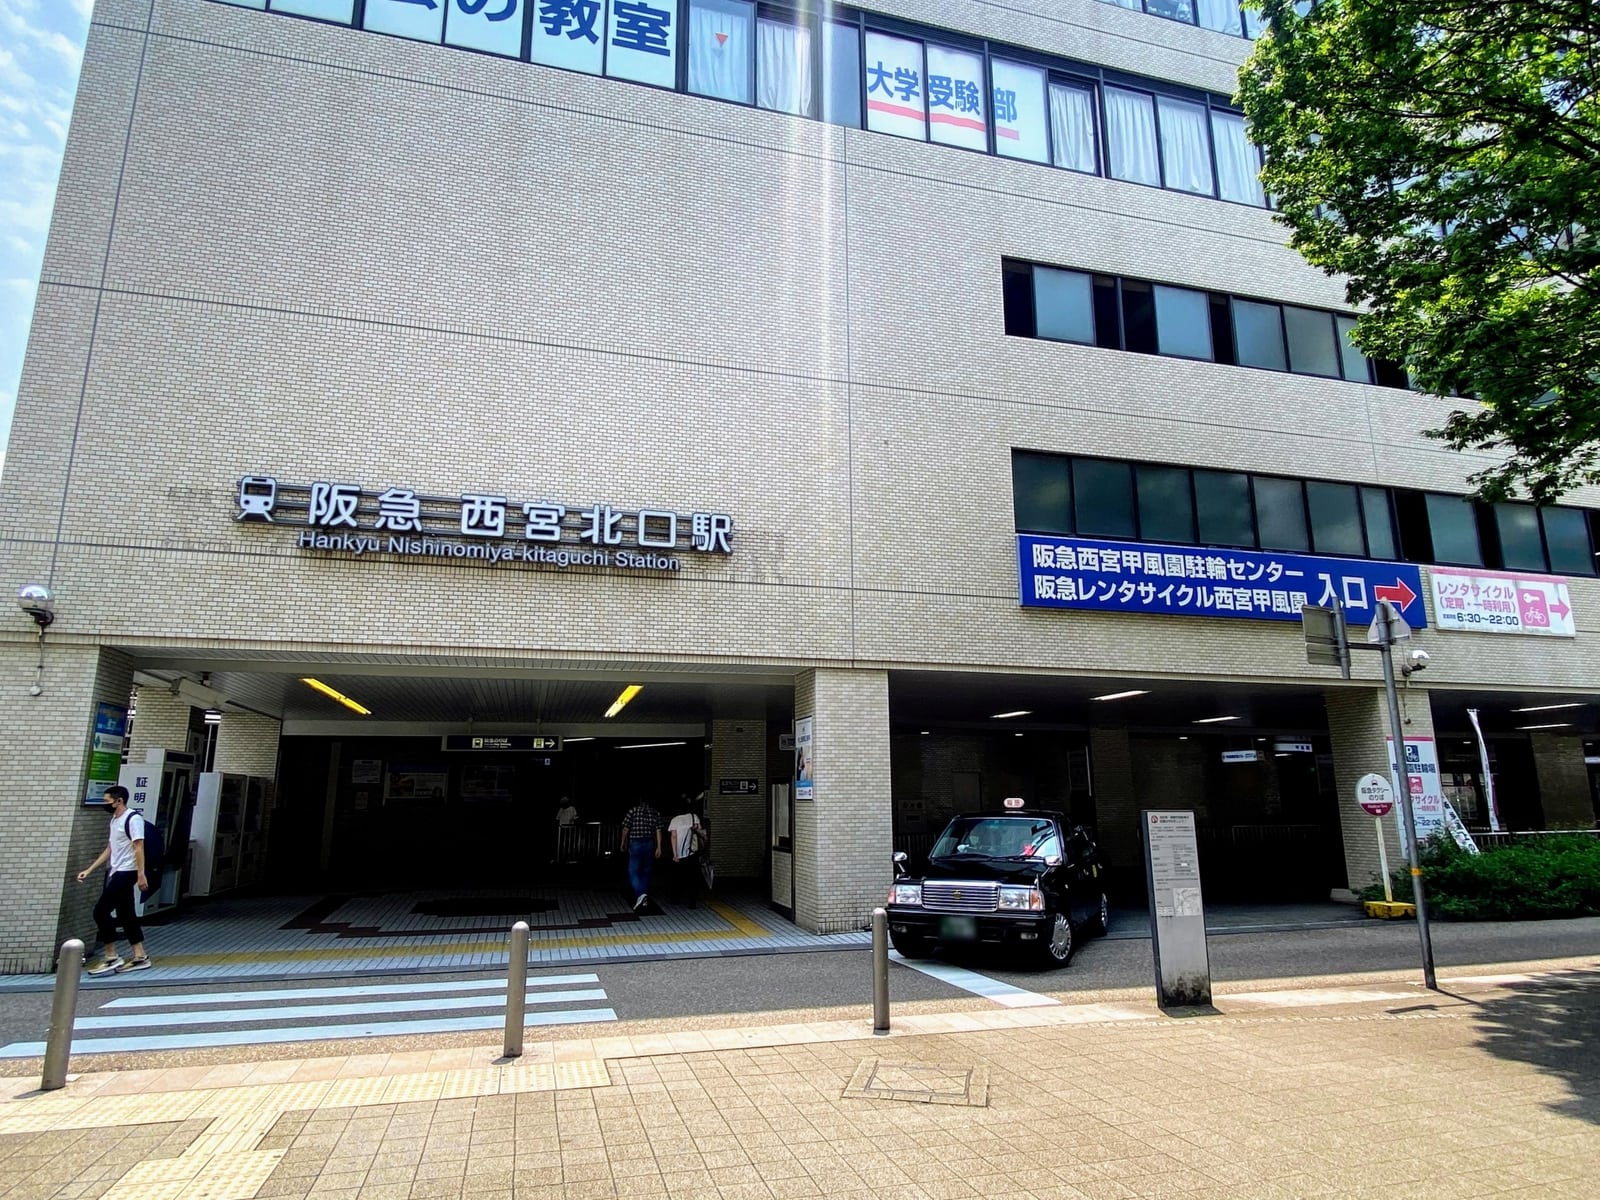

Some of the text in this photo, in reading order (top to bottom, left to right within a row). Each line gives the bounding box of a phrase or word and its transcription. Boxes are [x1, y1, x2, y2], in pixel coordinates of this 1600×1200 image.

[867, 61, 1018, 122] 大学受験部
[309, 482, 732, 552] 阪急 西宮北口駅
[300, 531, 680, 571] Hankyu Nishinomiya-kitaguchi Station
[1032, 543, 1304, 582] 阪急西宮甲風園駐輪センター
[1034, 575, 1308, 614] 阪急レンタサイクル西宮甲風園
[1318, 573, 1369, 610] 入口
[1437, 581, 1514, 600] レンタサイクル
[1392, 763, 1436, 773] 甲園駐輪場
